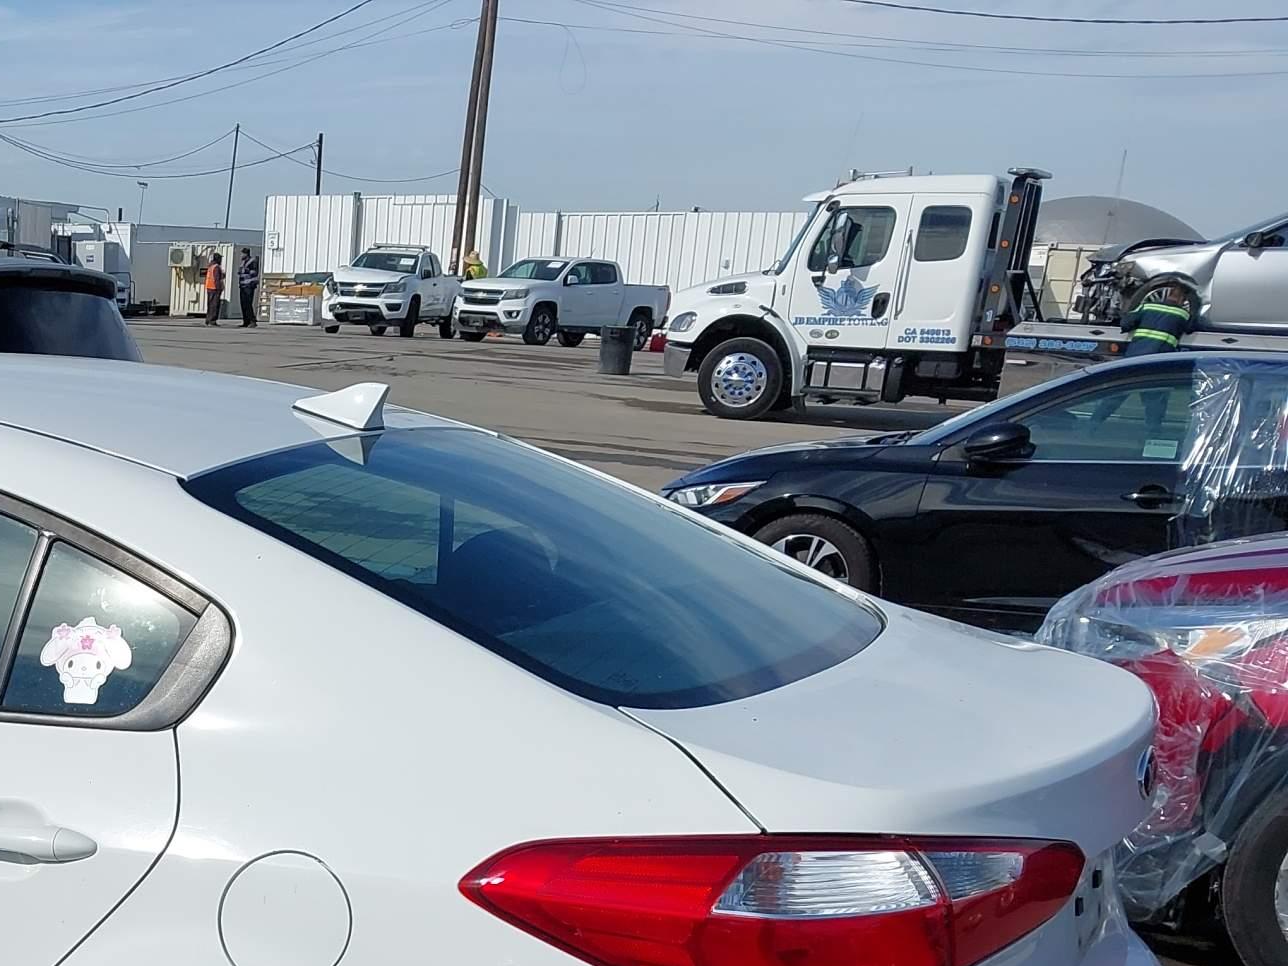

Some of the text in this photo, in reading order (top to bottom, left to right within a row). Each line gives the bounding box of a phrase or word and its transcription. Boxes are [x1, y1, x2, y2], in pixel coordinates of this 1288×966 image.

[806, 317, 845, 326] EMPIRE
[847, 318, 888, 326] TOWING
[904, 328, 917, 336] CA
